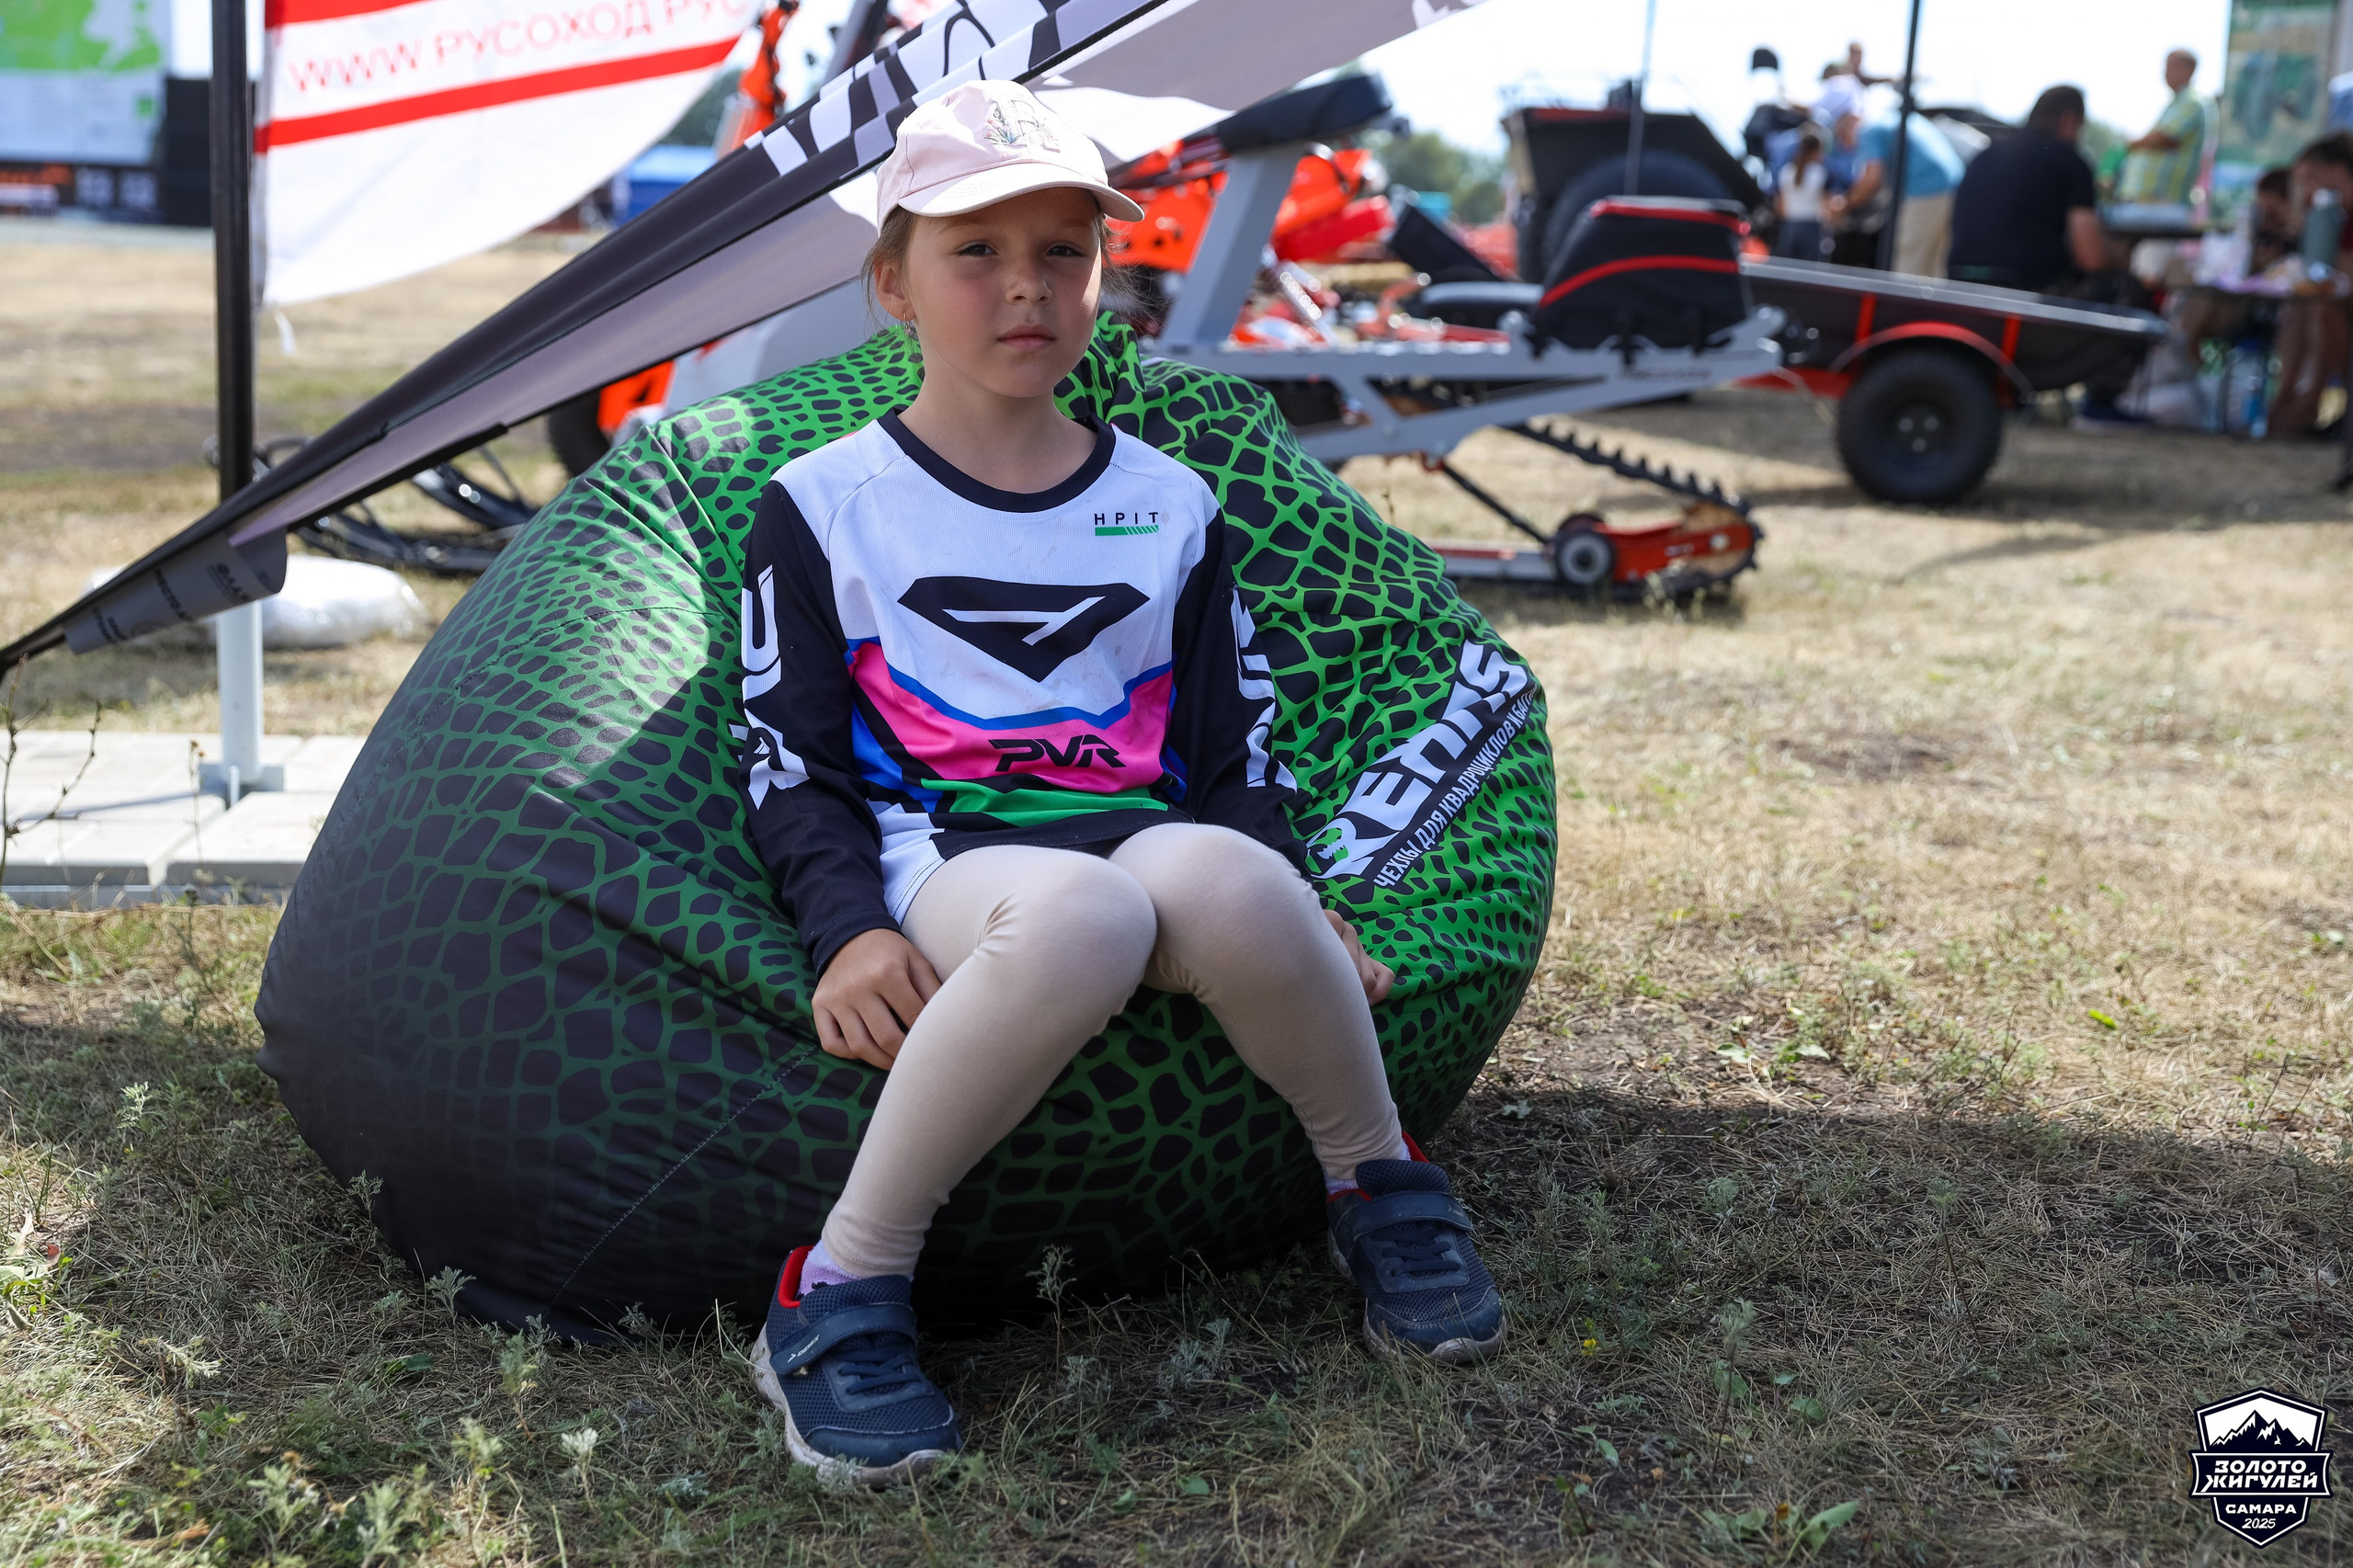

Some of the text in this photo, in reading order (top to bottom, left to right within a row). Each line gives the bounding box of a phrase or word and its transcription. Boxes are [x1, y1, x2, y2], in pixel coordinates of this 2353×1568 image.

[287, 39, 423, 92] WWW
[434, 0, 654, 65] РУСОХОД
[1094, 511, 1159, 526] HPIT
[987, 733, 1127, 772] PVR
[1372, 839, 1424, 887] ЧЕХЛЫ
[1414, 809, 1449, 851] ДЛЯ
[1438, 720, 1516, 819] КВАДРОЦИКЛОВ
[1506, 711, 1524, 729] И
